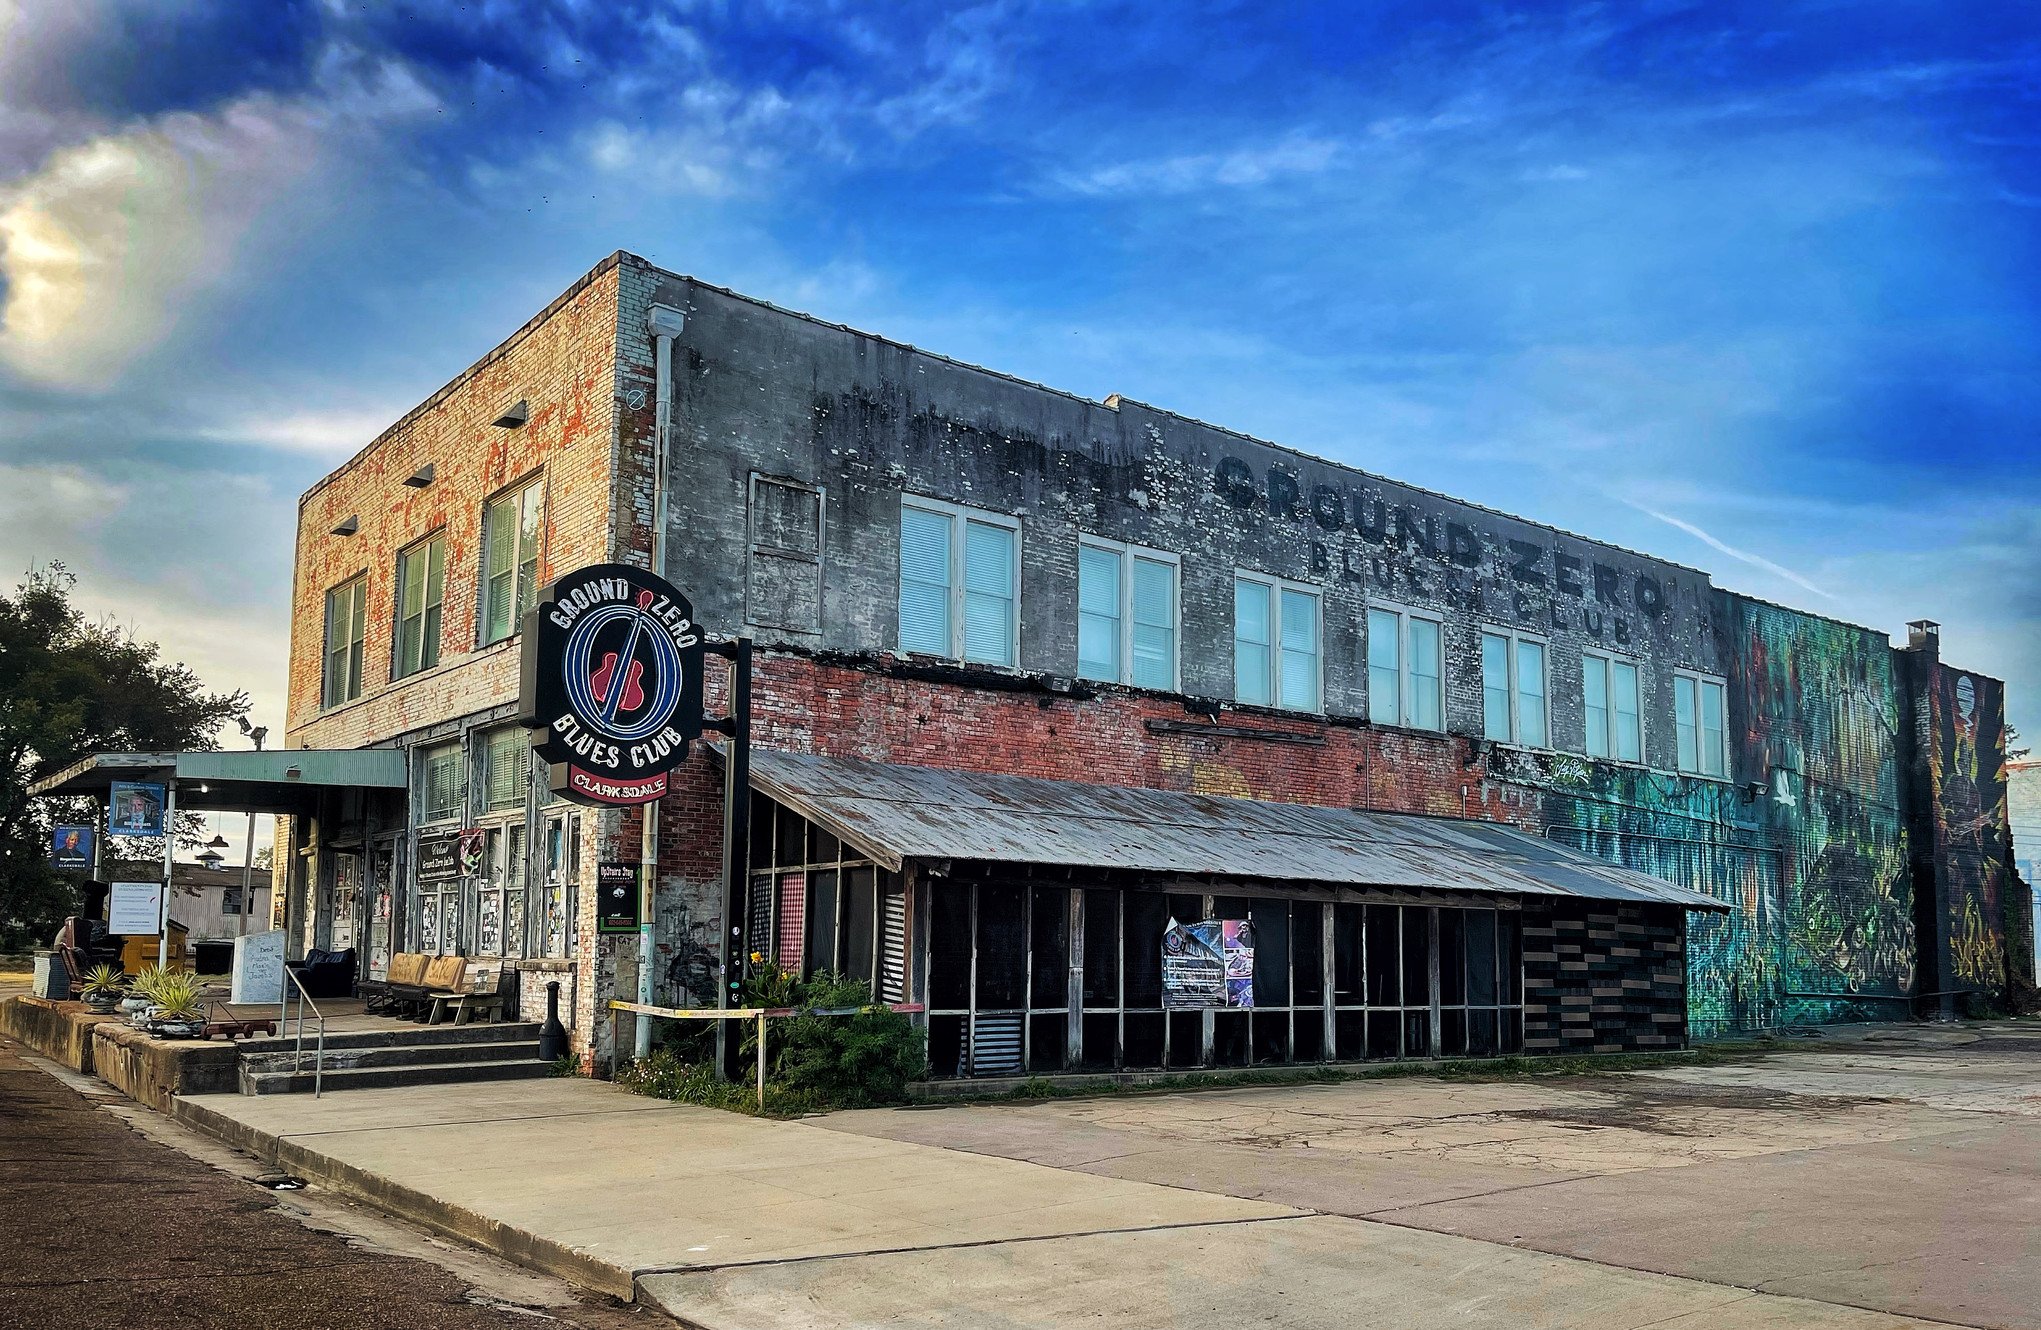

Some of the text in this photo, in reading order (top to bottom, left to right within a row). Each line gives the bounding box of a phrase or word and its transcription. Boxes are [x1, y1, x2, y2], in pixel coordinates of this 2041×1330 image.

[1214, 456, 1665, 619] GROUND ZERO
[550, 578, 698, 649] GROUND ZERO
[1513, 591, 1631, 646] CLUB
[553, 712, 683, 768] BLUES CLUB
[574, 774, 666, 798] CLARKSDALE
